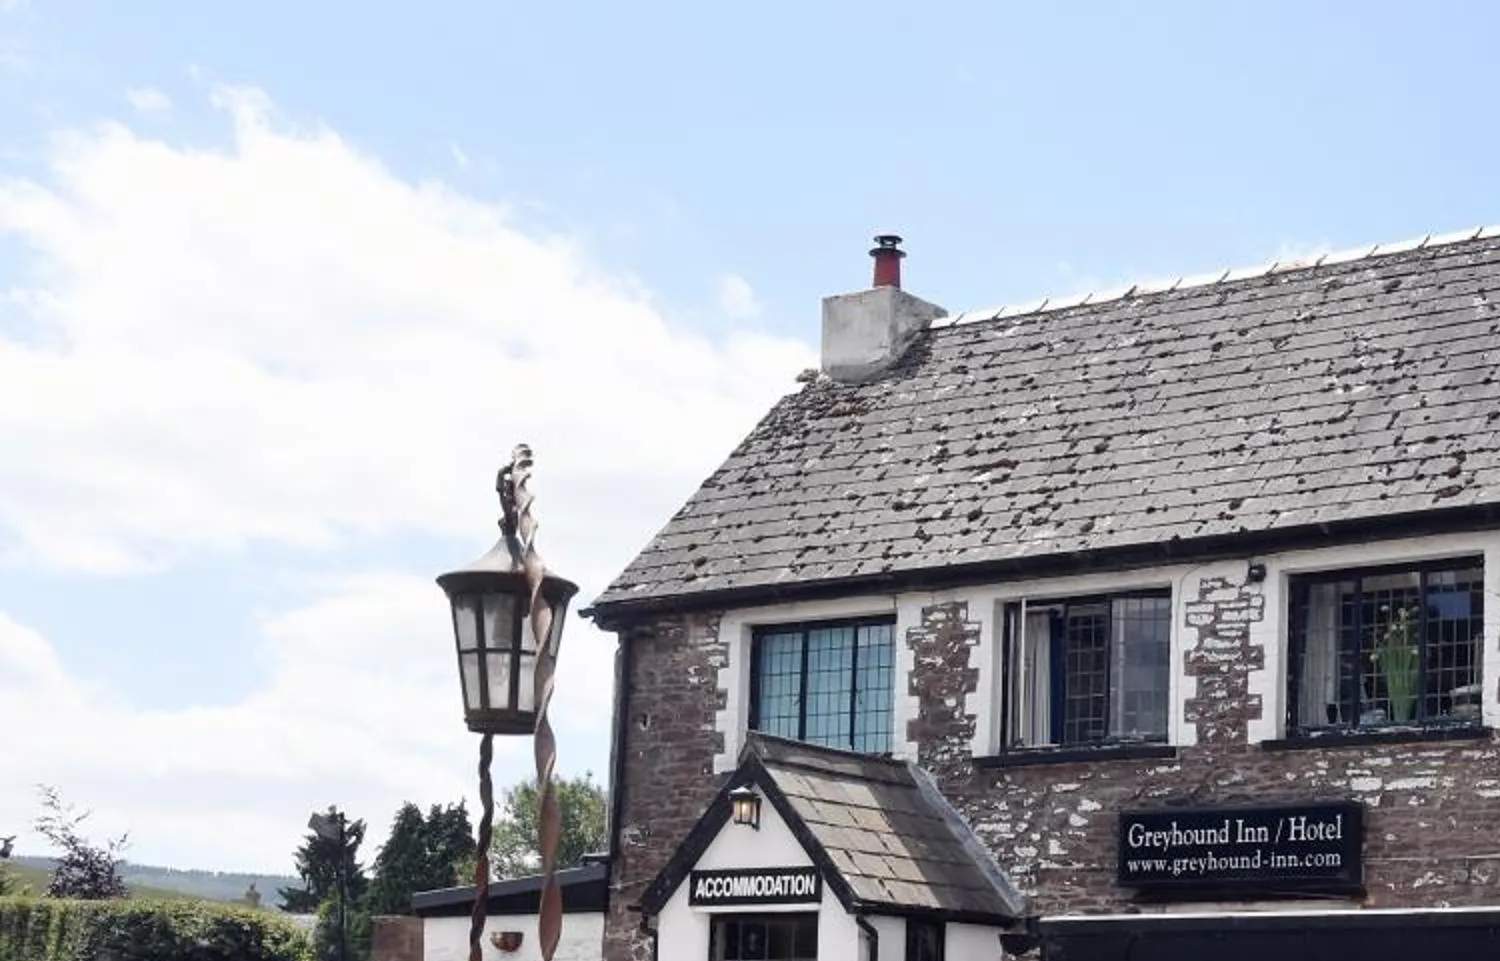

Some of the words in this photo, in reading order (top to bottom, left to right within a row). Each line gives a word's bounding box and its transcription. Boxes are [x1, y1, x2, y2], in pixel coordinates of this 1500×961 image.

[1128, 820, 1229, 851] Greyhound
[1236, 819, 1269, 843] Inn
[1275, 819, 1283, 844] /
[1288, 814, 1342, 842] Hotel
[1127, 850, 1341, 875] www.greyhound-inn.com
[695, 875, 816, 898] ACCOMMODATION
